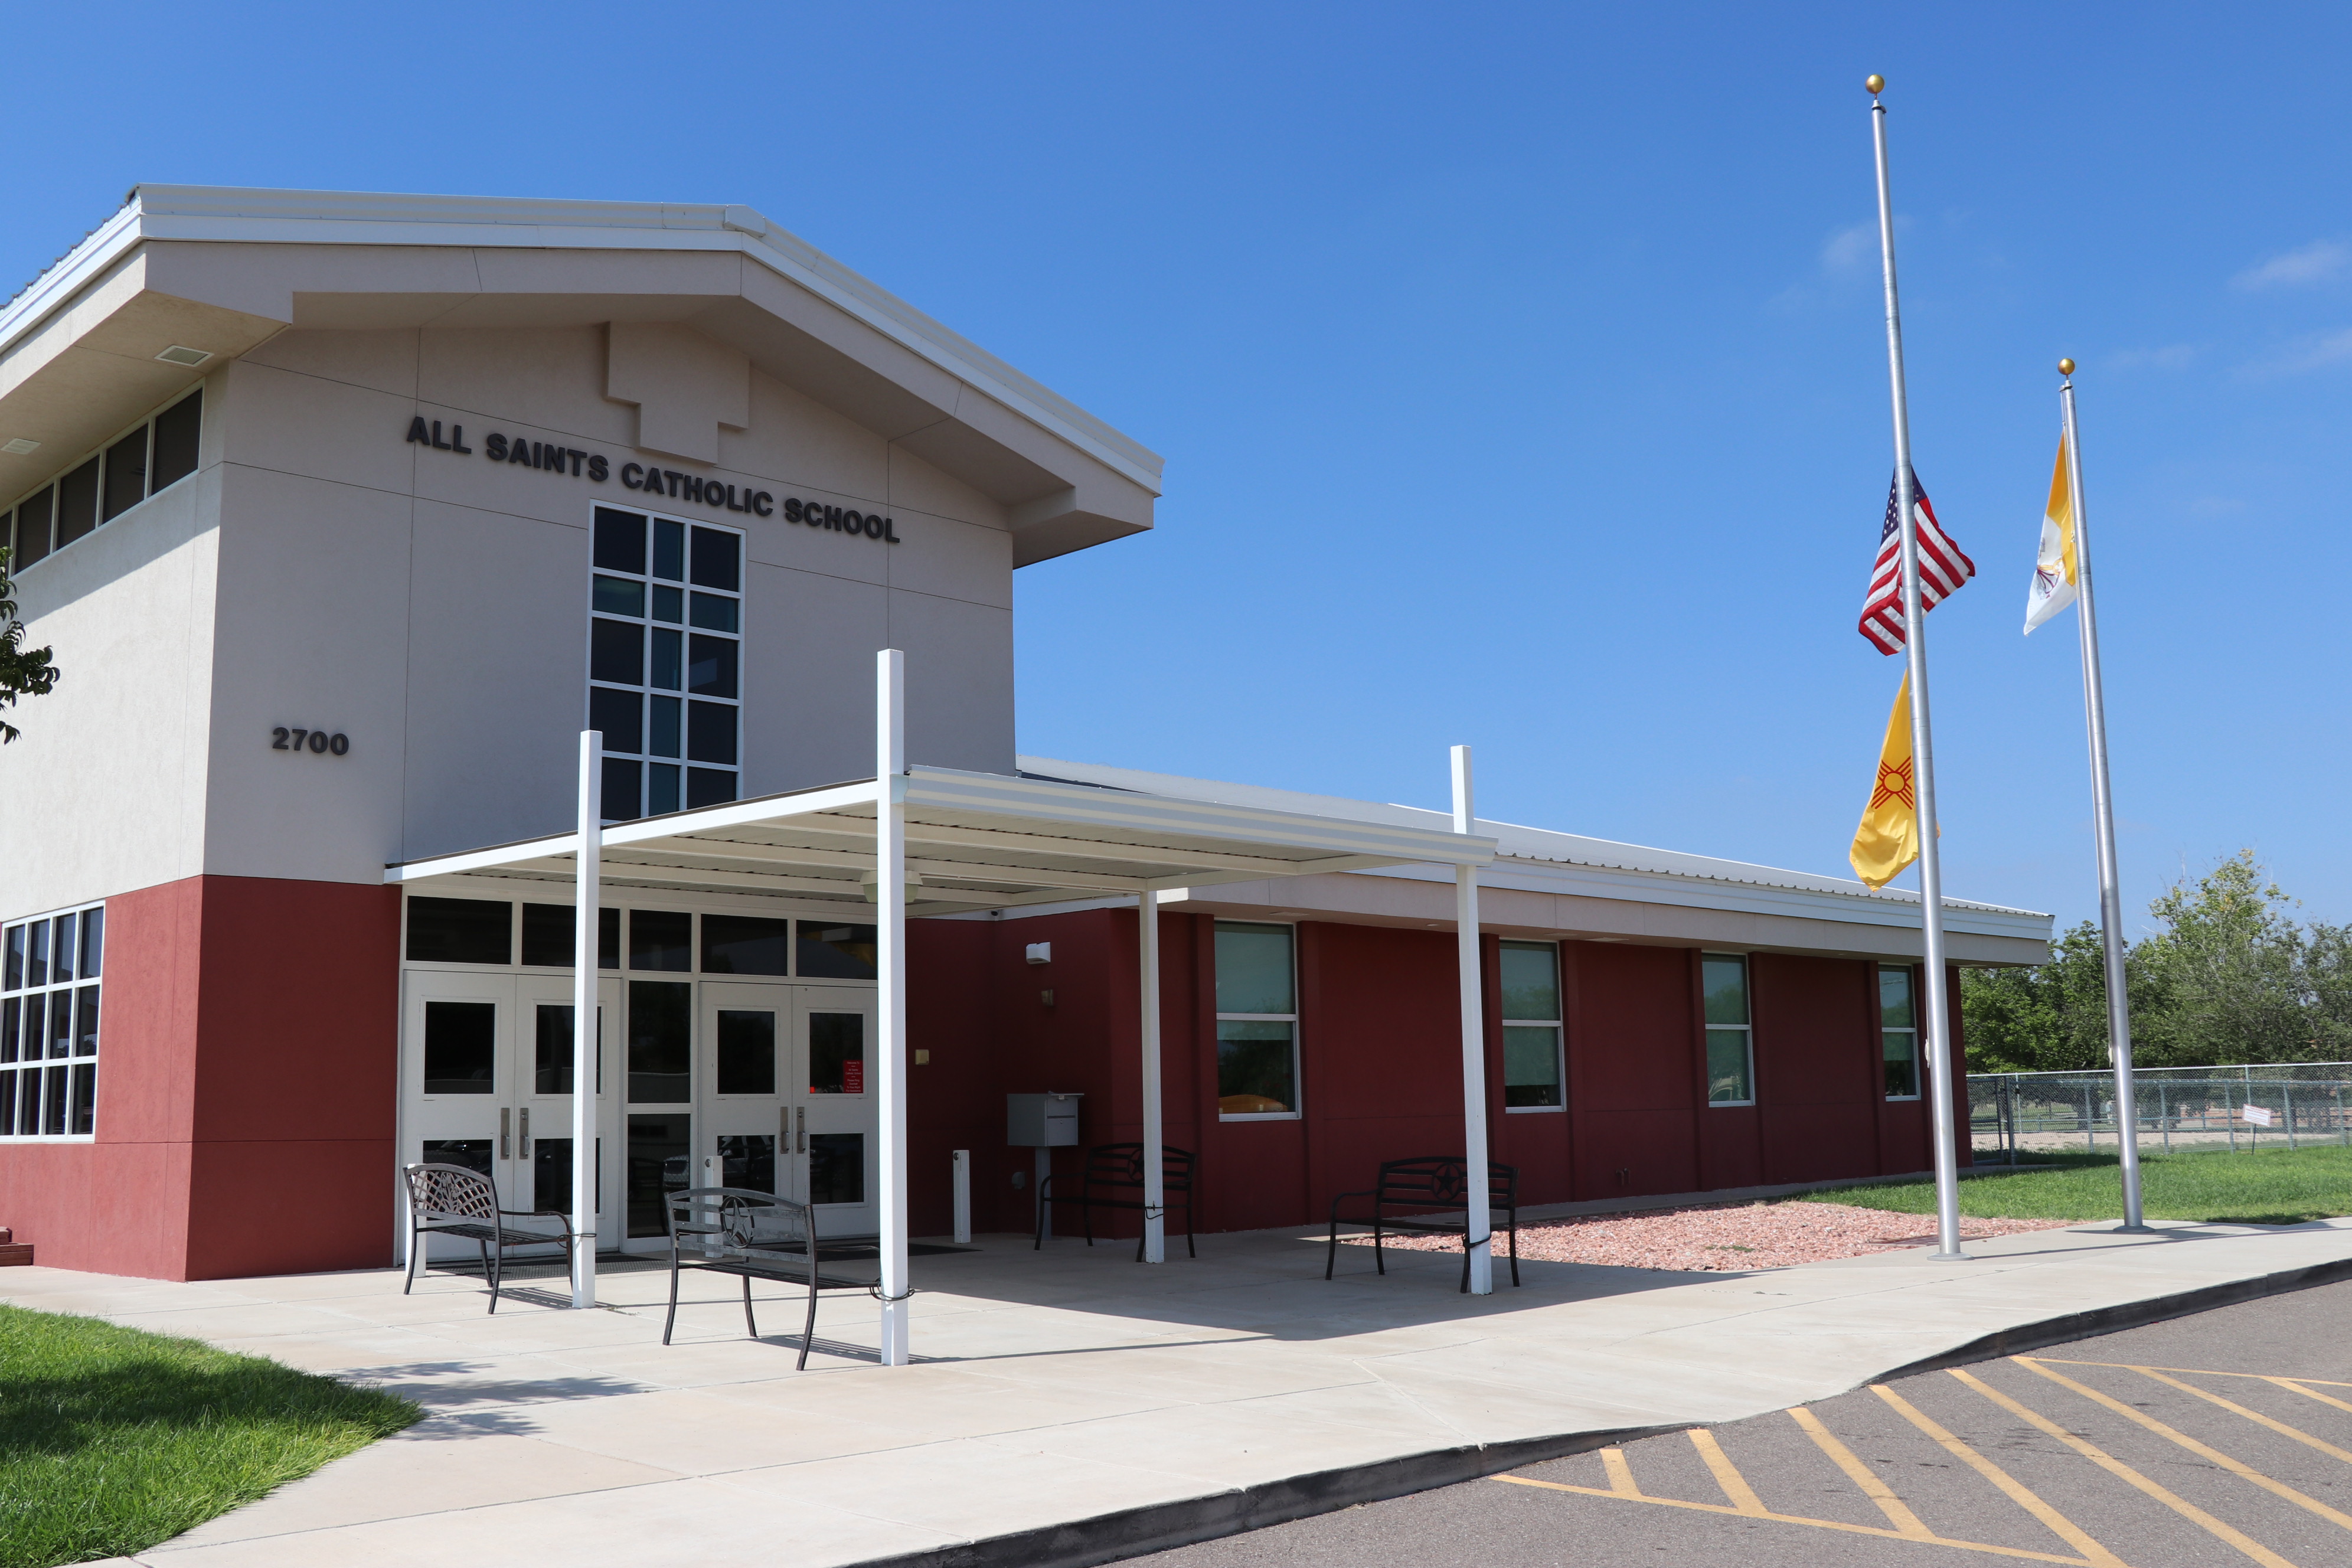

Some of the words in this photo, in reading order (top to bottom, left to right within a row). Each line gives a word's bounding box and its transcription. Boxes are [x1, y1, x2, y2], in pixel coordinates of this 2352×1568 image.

[407, 416, 472, 454] ALL
[486, 433, 609, 481] SAINTS
[622, 462, 773, 517] CATHOLIC
[785, 498, 900, 543] SCHOOL
[272, 727, 349, 756] 2700
